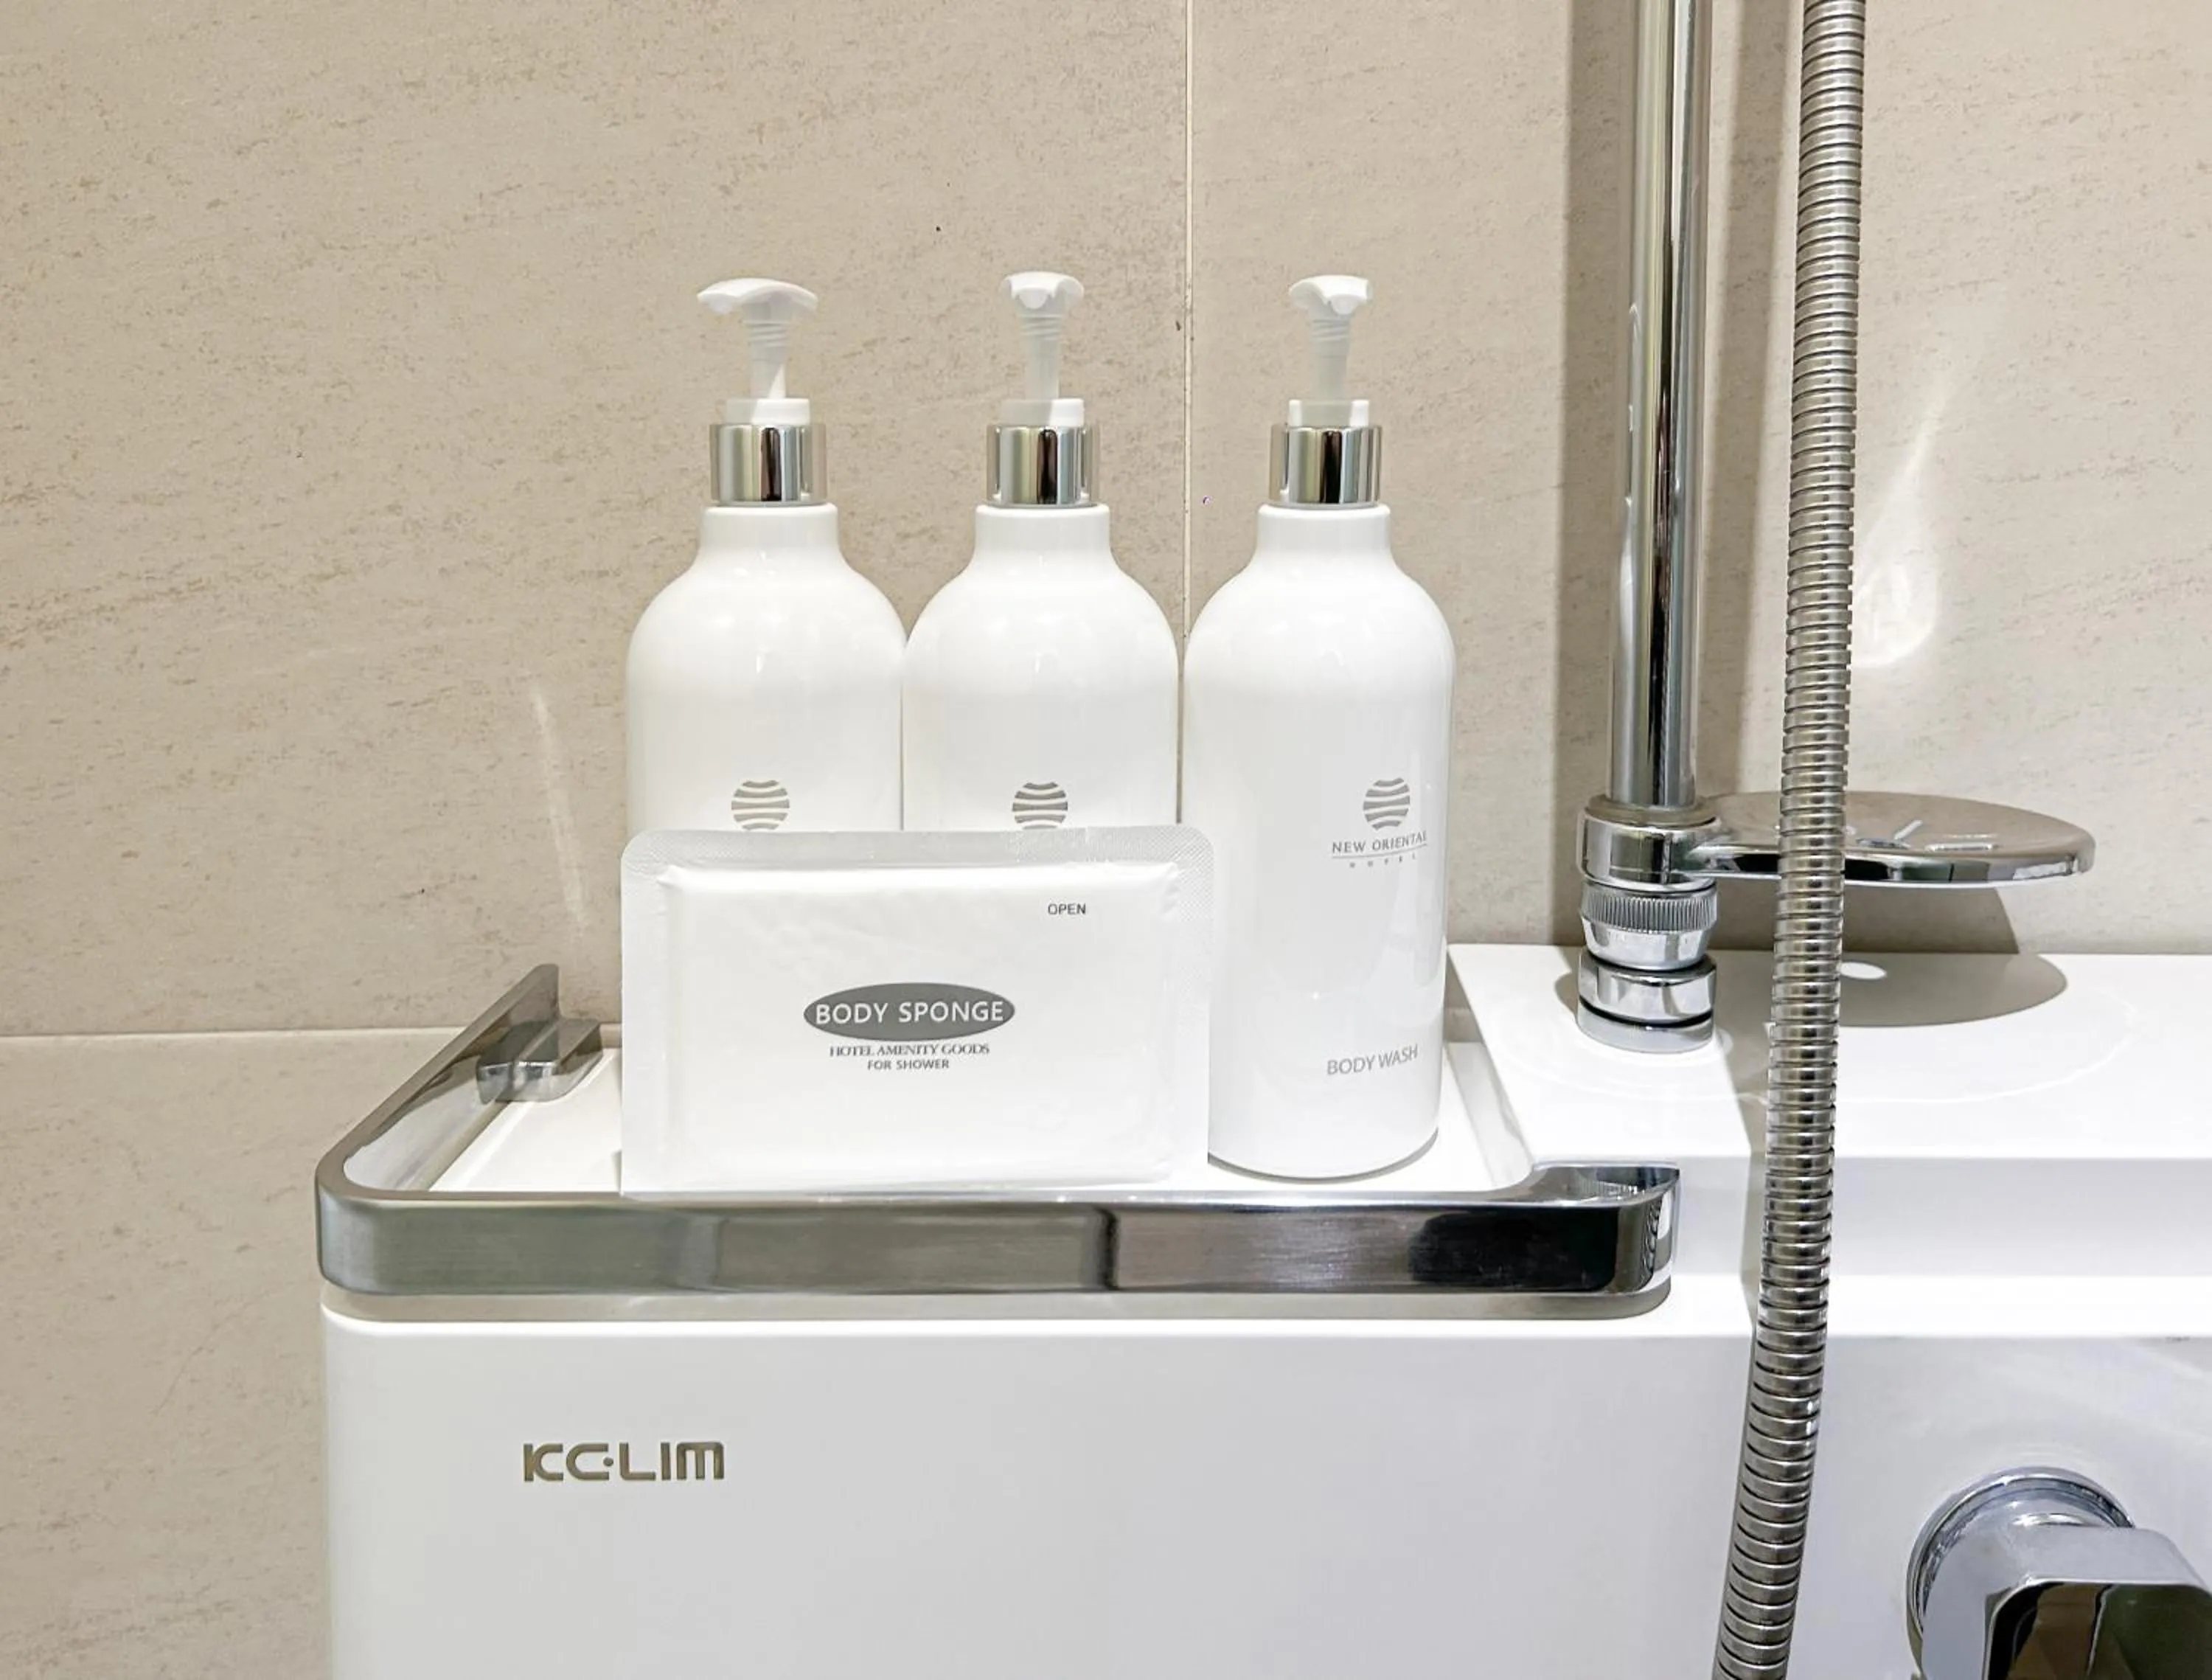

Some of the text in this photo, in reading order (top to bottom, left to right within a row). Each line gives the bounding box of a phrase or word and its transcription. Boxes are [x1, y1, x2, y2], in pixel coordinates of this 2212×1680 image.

[1332, 830, 1427, 853] NEW ORIENTAL
[1047, 903, 1087, 915] OPEN
[815, 1001, 1004, 1024] BODY SPONGE
[830, 1043, 990, 1057] HOTEL AMENITY GOODS
[867, 1058, 950, 1070] FOR SHOWER
[1327, 1044, 1418, 1075] BODY WASH
